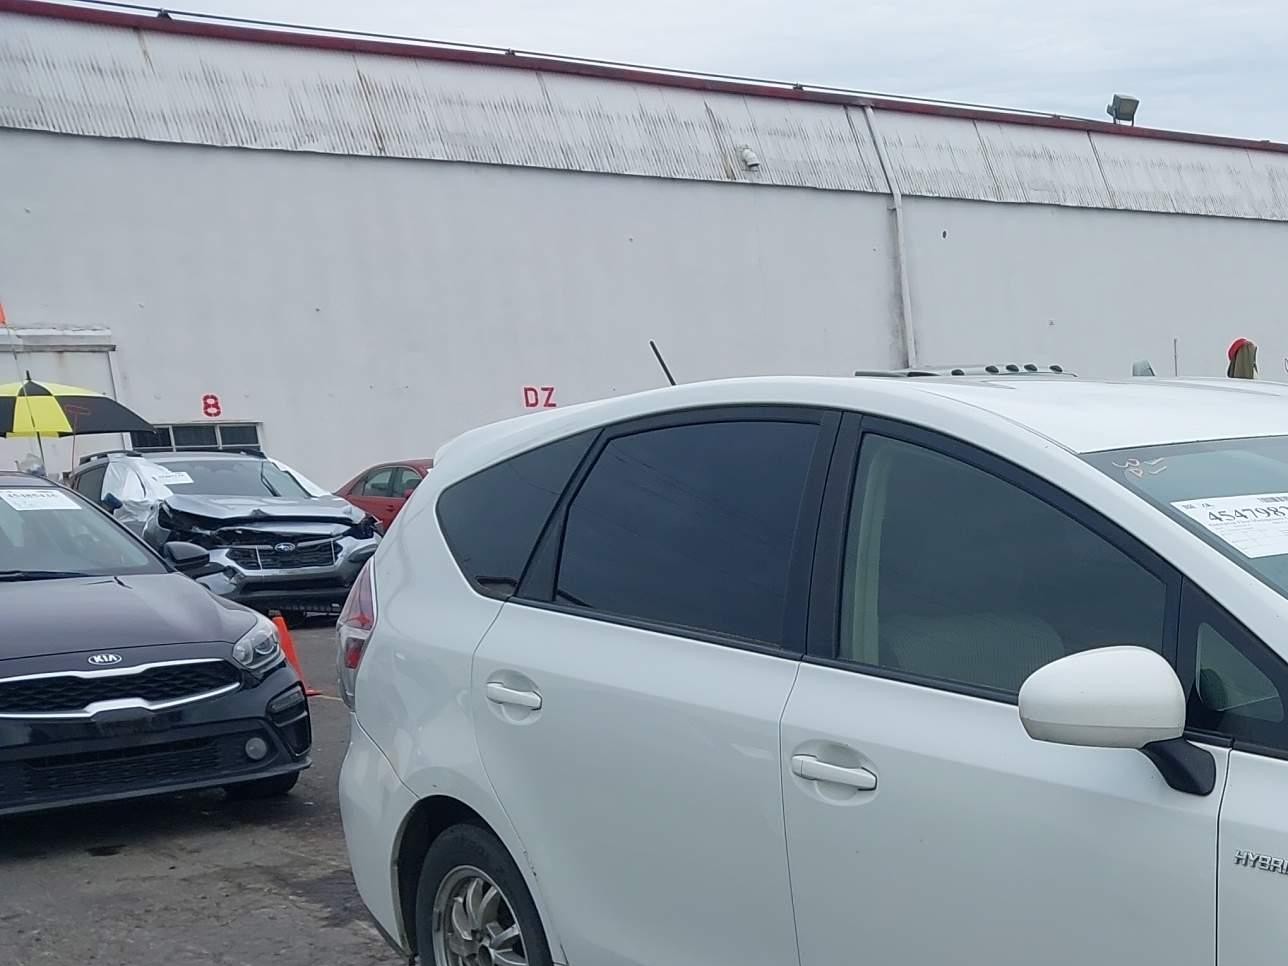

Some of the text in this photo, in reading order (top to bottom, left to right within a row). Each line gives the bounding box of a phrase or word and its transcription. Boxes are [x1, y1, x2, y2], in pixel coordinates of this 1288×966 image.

[203, 394, 222, 417] 8
[523, 386, 557, 408] DZ
[93, 654, 118, 663] KIA
